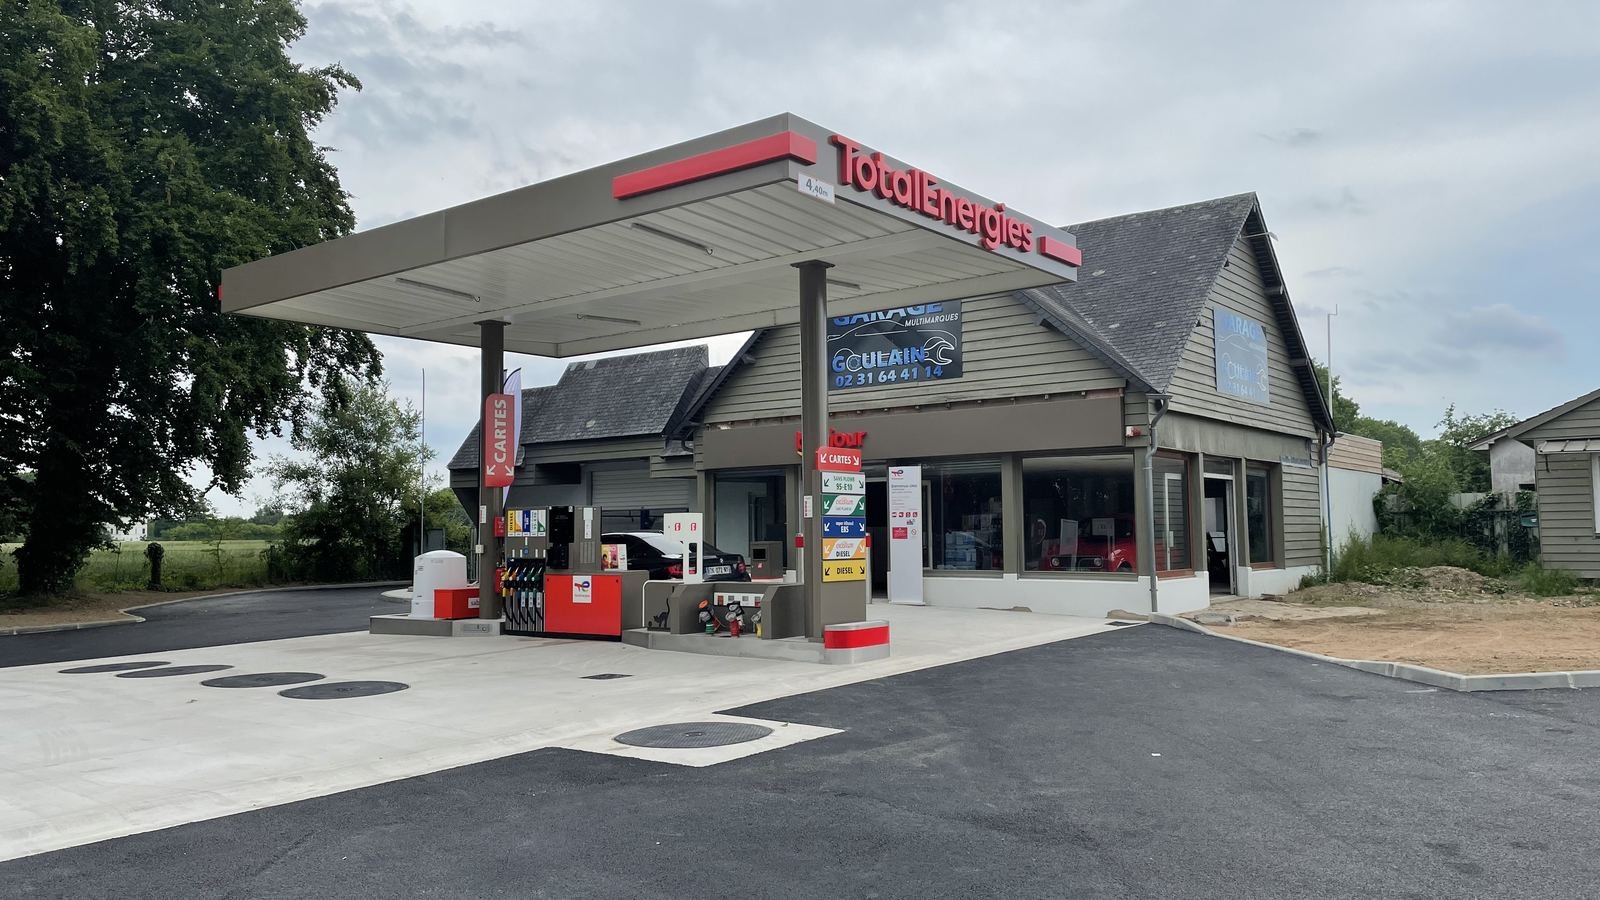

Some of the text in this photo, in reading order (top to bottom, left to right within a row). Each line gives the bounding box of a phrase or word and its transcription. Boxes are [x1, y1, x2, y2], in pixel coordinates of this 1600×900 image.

[830, 134, 1034, 252] TotalEnergies
[904, 313, 959, 327] MULTIMARQUES
[836, 365, 943, 387] 02 31 64 41 14
[494, 399, 507, 463] CARTES
[829, 454, 852, 465] CARTES
[836, 567, 853, 575] DIESEL
